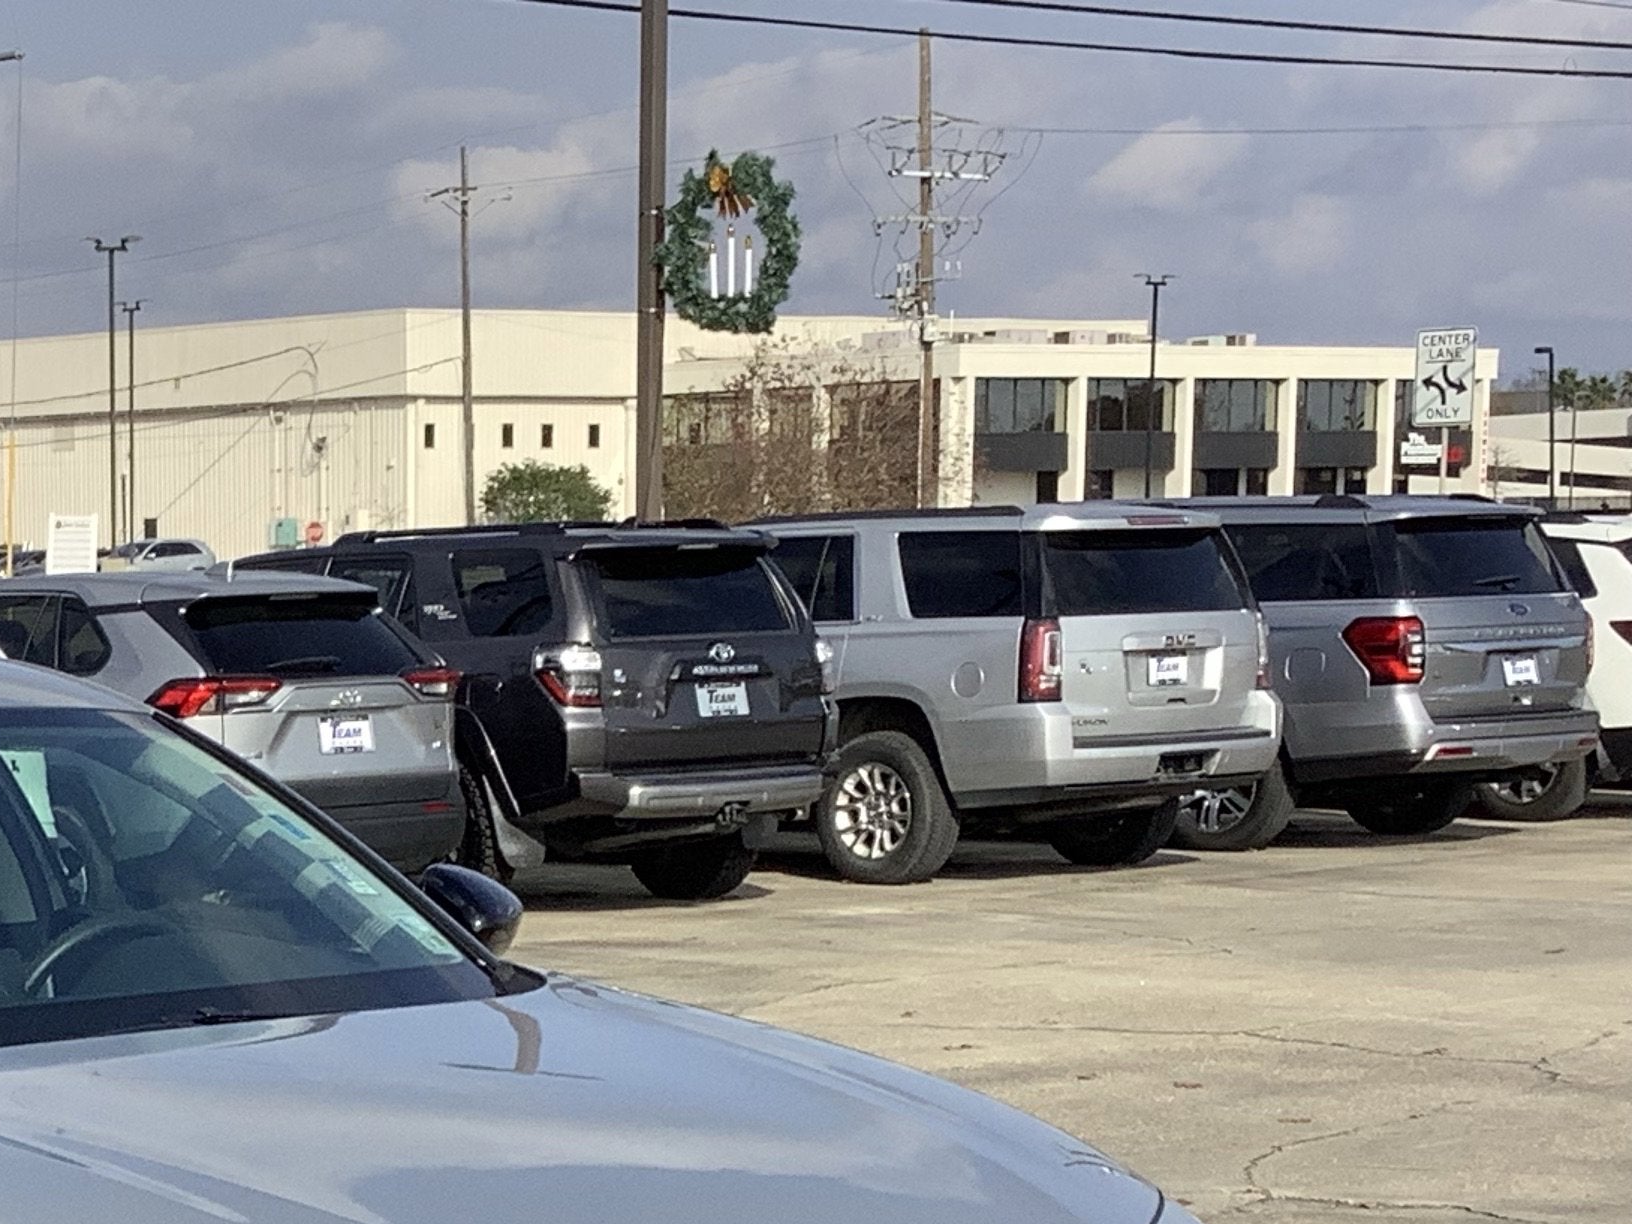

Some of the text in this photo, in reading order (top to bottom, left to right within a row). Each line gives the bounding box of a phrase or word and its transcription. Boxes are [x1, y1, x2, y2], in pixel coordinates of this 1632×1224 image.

[1422, 333, 1471, 347] CENTER
[1429, 346, 1463, 360] LANE
[1426, 407, 1461, 420] ONLY
